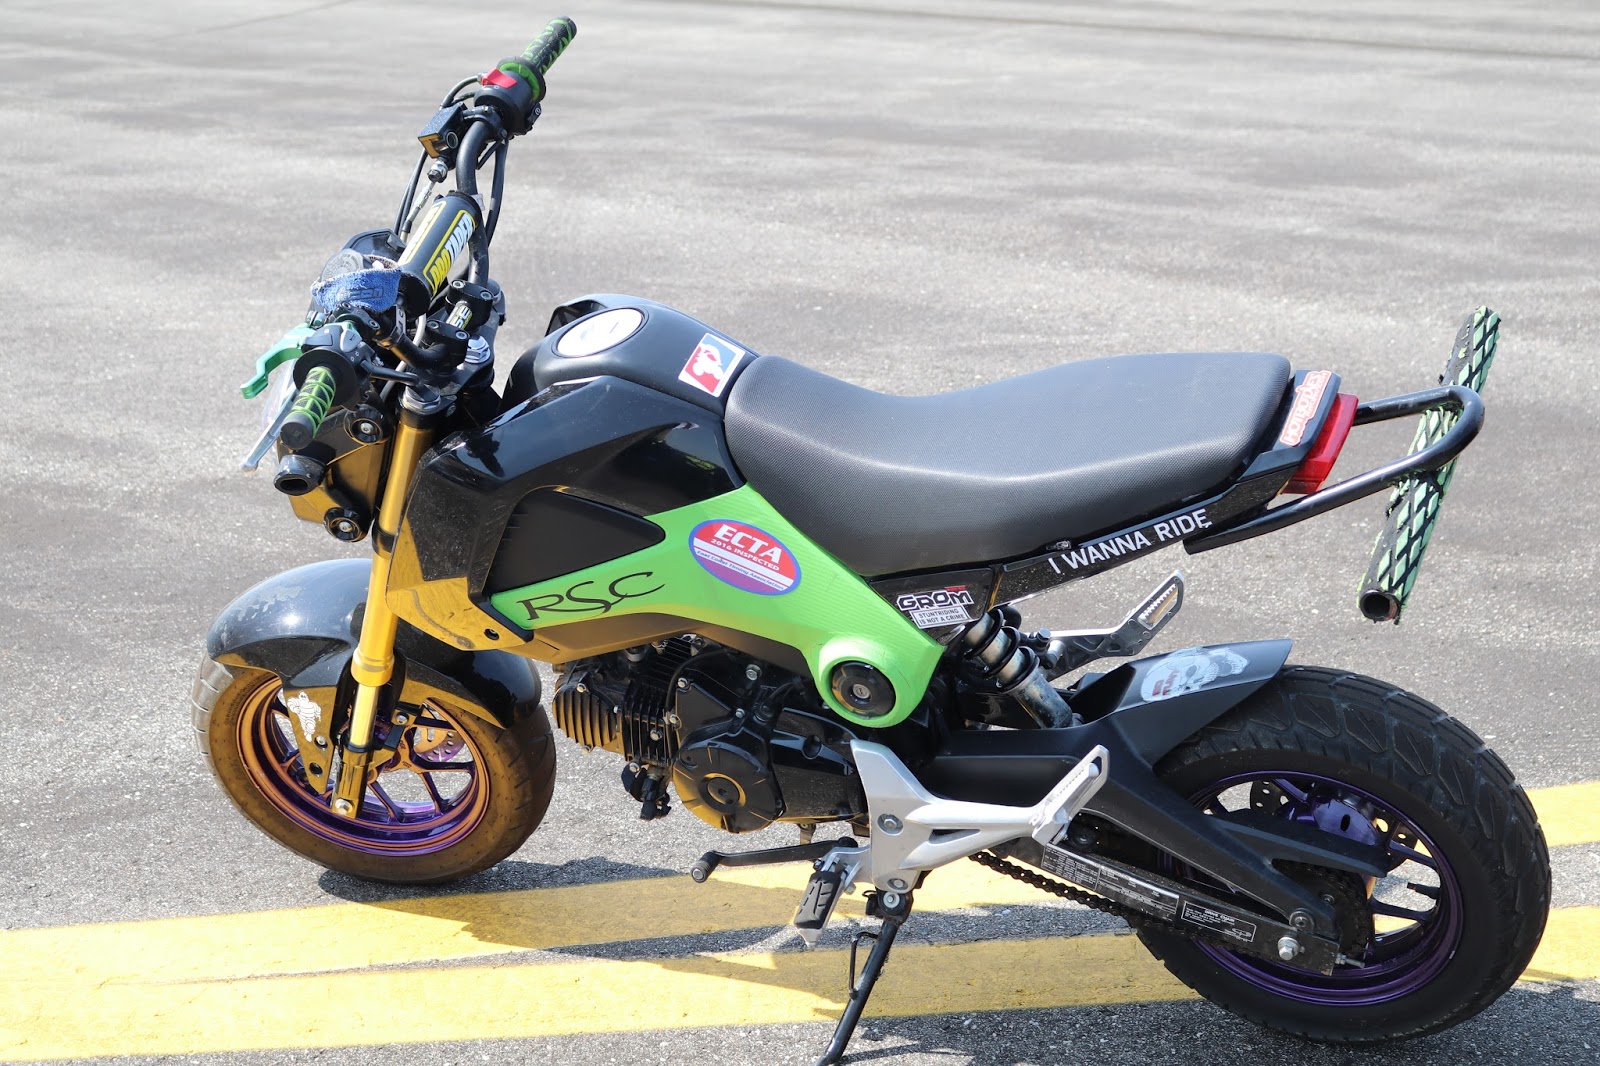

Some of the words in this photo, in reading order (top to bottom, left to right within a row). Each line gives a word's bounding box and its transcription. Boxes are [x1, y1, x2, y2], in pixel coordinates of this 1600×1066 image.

[711, 539, 732, 550] 2016
[733, 548, 780, 571] INSPECTED
[714, 524, 782, 564] ECTA
[1048, 558, 1061, 574] I
[1061, 531, 1152, 569] WANNA
[1153, 508, 1212, 541] RIDE
[696, 550, 711, 559] East
[728, 563, 749, 575] Timing
[749, 572, 784, 590] Association
[516, 571, 665, 621] RSC
[897, 591, 974, 611] GROM
[918, 608, 959, 618] STUNTRIDING
